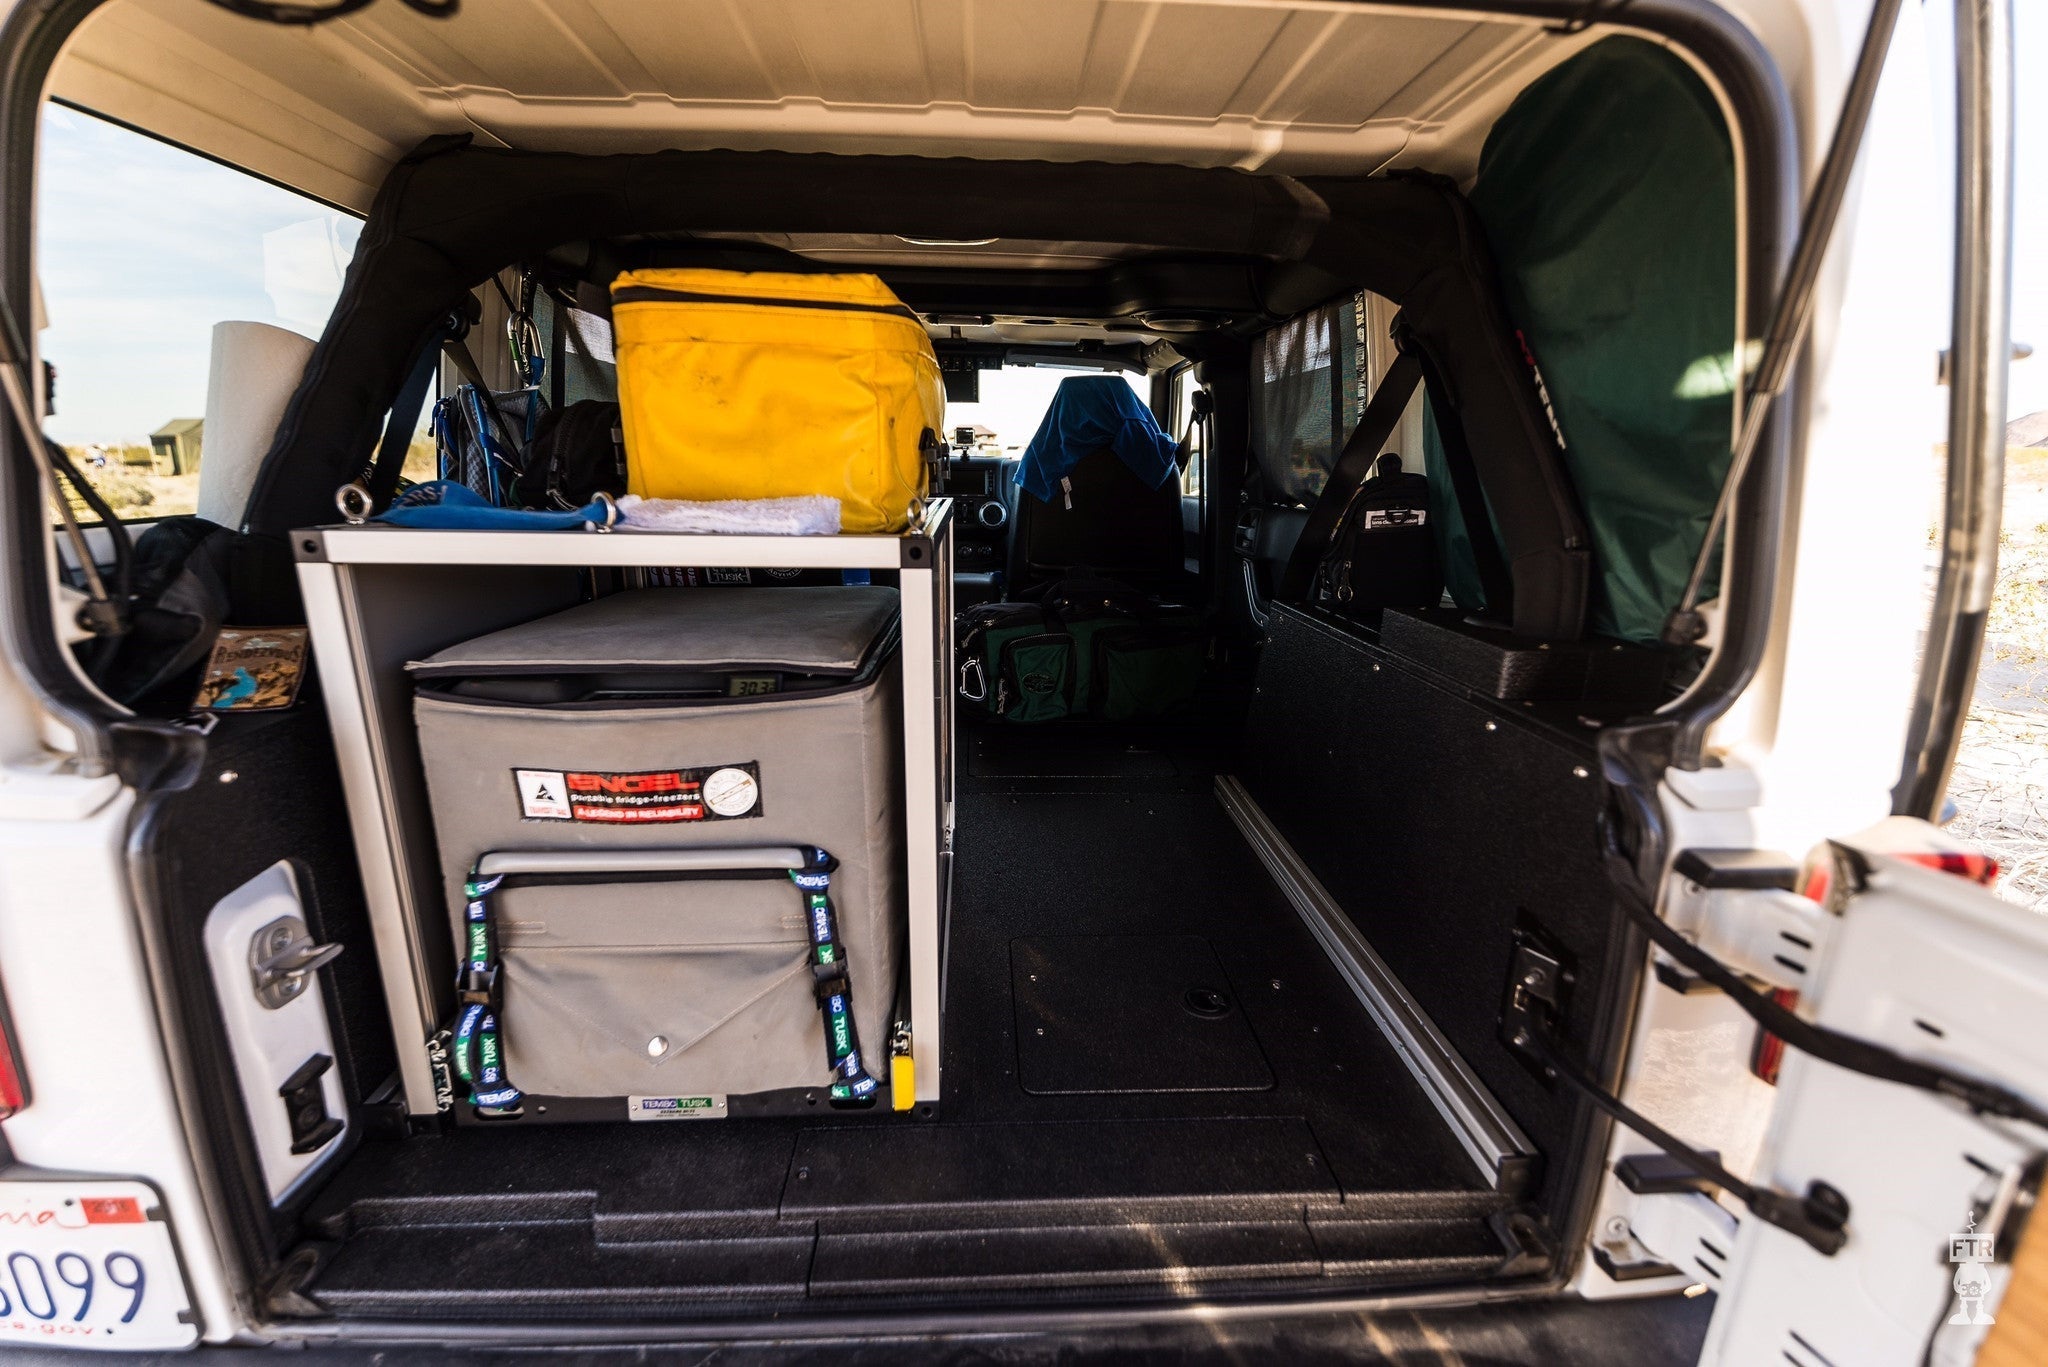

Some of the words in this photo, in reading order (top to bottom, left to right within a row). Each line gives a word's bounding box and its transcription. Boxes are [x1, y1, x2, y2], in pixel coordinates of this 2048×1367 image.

[567, 773, 700, 793] ENGEL
[570, 793, 614, 804] Portable
[615, 793, 701, 806] fridge-freezers
[586, 809, 624, 819] LEGEND
[625, 811, 638, 819] IN
[638, 808, 700, 819] RELIABILITY
[835, 1016, 848, 1051] TUSK
[483, 1037, 497, 1065] TUSK
[643, 1100, 677, 1109] TEMBO
[680, 1098, 708, 1108] TUSK
